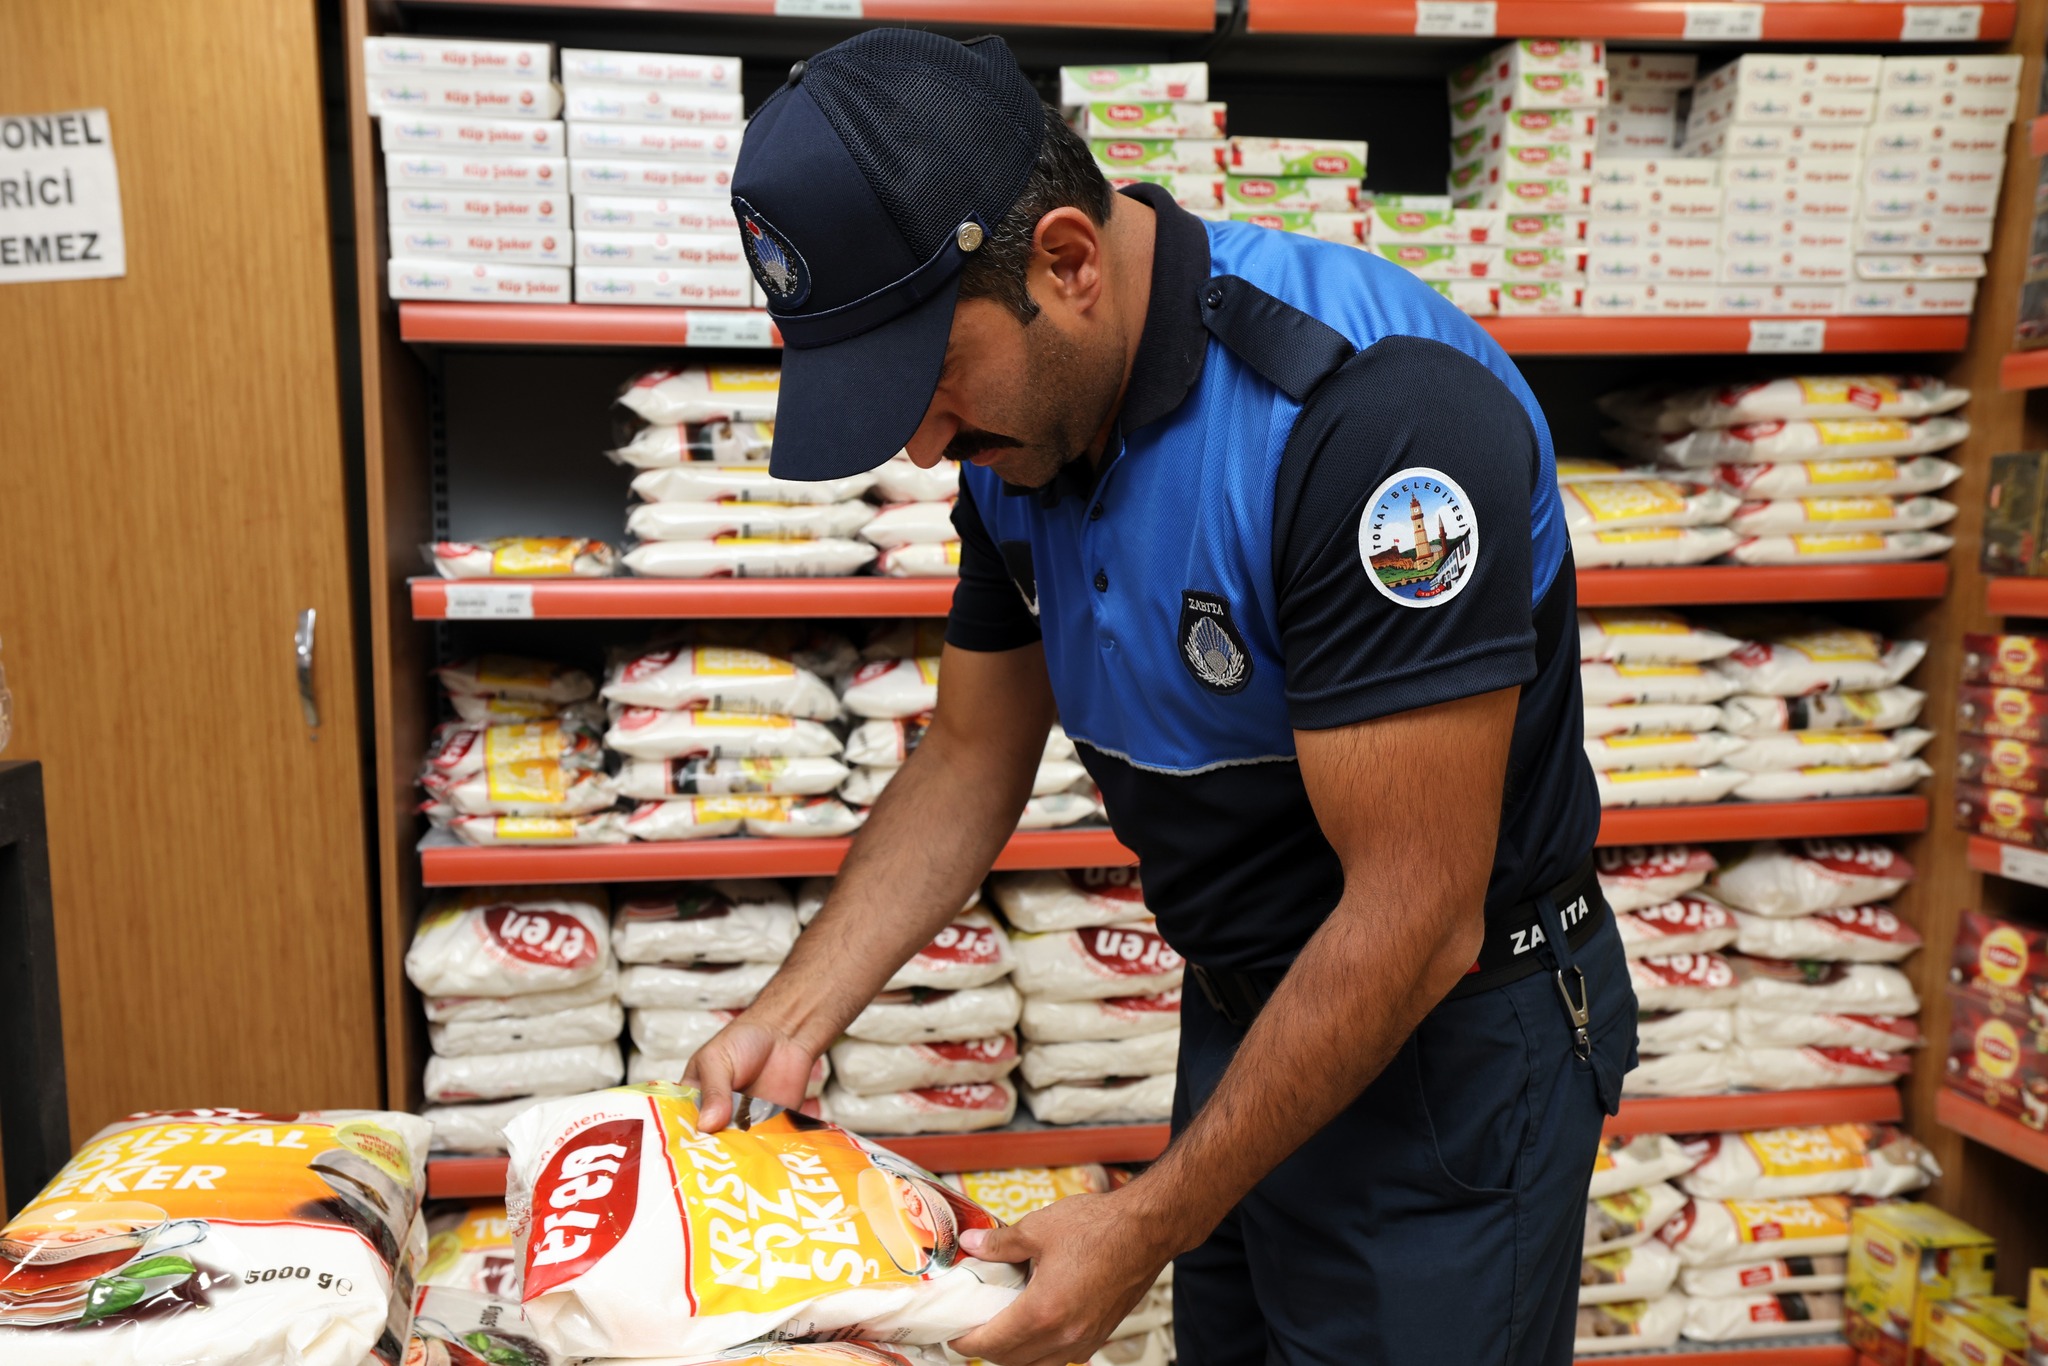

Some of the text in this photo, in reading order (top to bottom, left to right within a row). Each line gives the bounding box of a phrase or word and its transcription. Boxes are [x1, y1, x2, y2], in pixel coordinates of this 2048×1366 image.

[2, 114, 104, 149] ONEL
[0, 168, 75, 209] RİCİ
[0, 233, 103, 265] EMEZ
[1372, 481, 1468, 550] TOKAT BELEDİYESİ
[1188, 598, 1224, 616] ZABITA
[499, 910, 586, 962] eren
[934, 926, 1000, 956] ere
[1510, 895, 1589, 955] ZAITA
[1095, 929, 1182, 969] eren
[62, 1145, 175, 1179] OZ
[46, 1165, 228, 1200] EKER
[532, 1143, 627, 1267] eren
[778, 1153, 880, 1287] ŞEKER
[745, 1182, 812, 1293] TOZ
[244, 1266, 310, 1285] 5000
